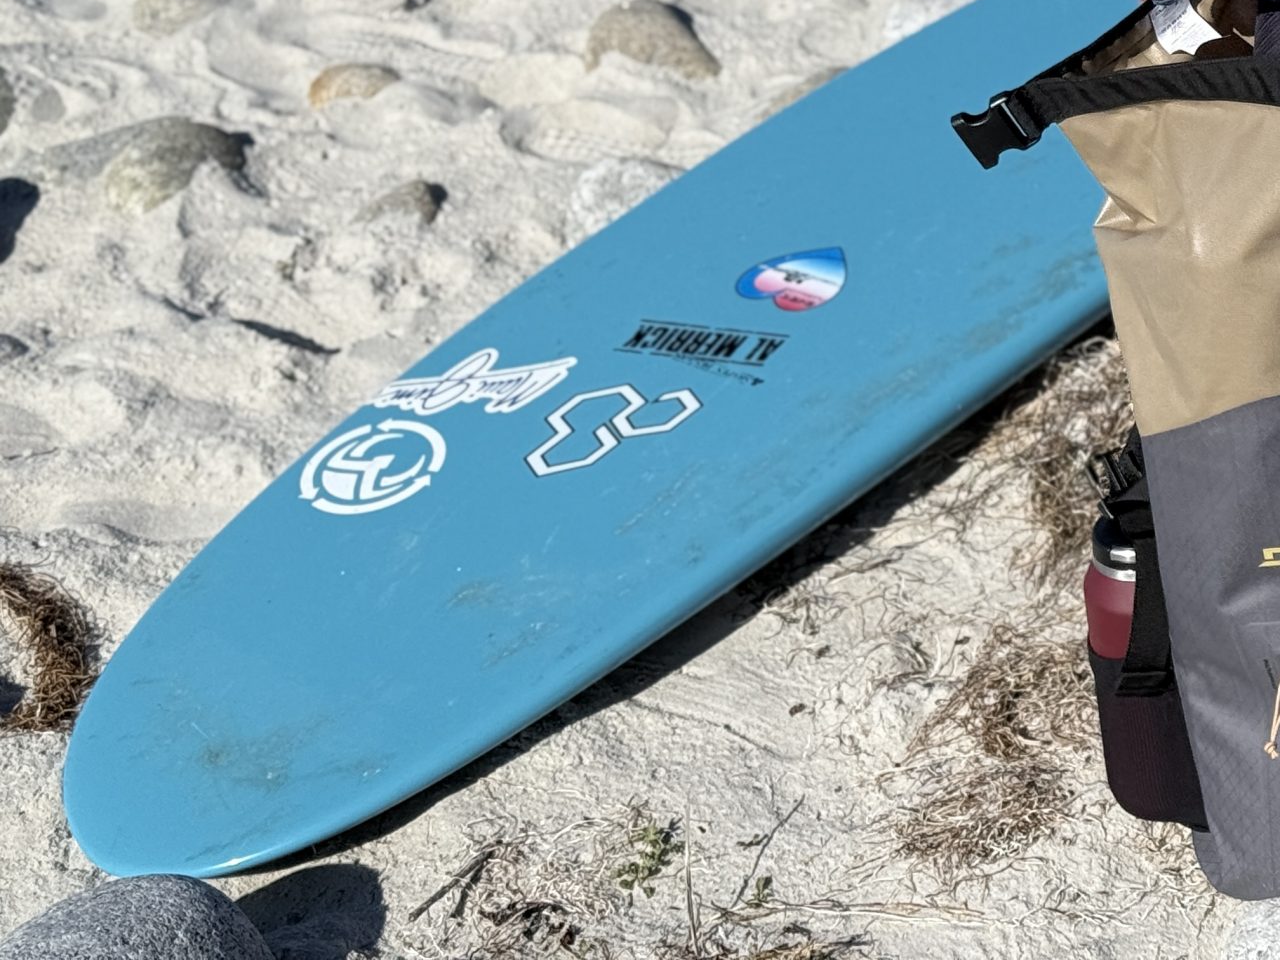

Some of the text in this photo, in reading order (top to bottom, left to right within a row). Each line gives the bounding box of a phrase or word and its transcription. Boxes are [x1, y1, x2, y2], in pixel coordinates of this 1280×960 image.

[622, 324, 786, 362] AL MERRICK
[470, 371, 562, 408] Maui
